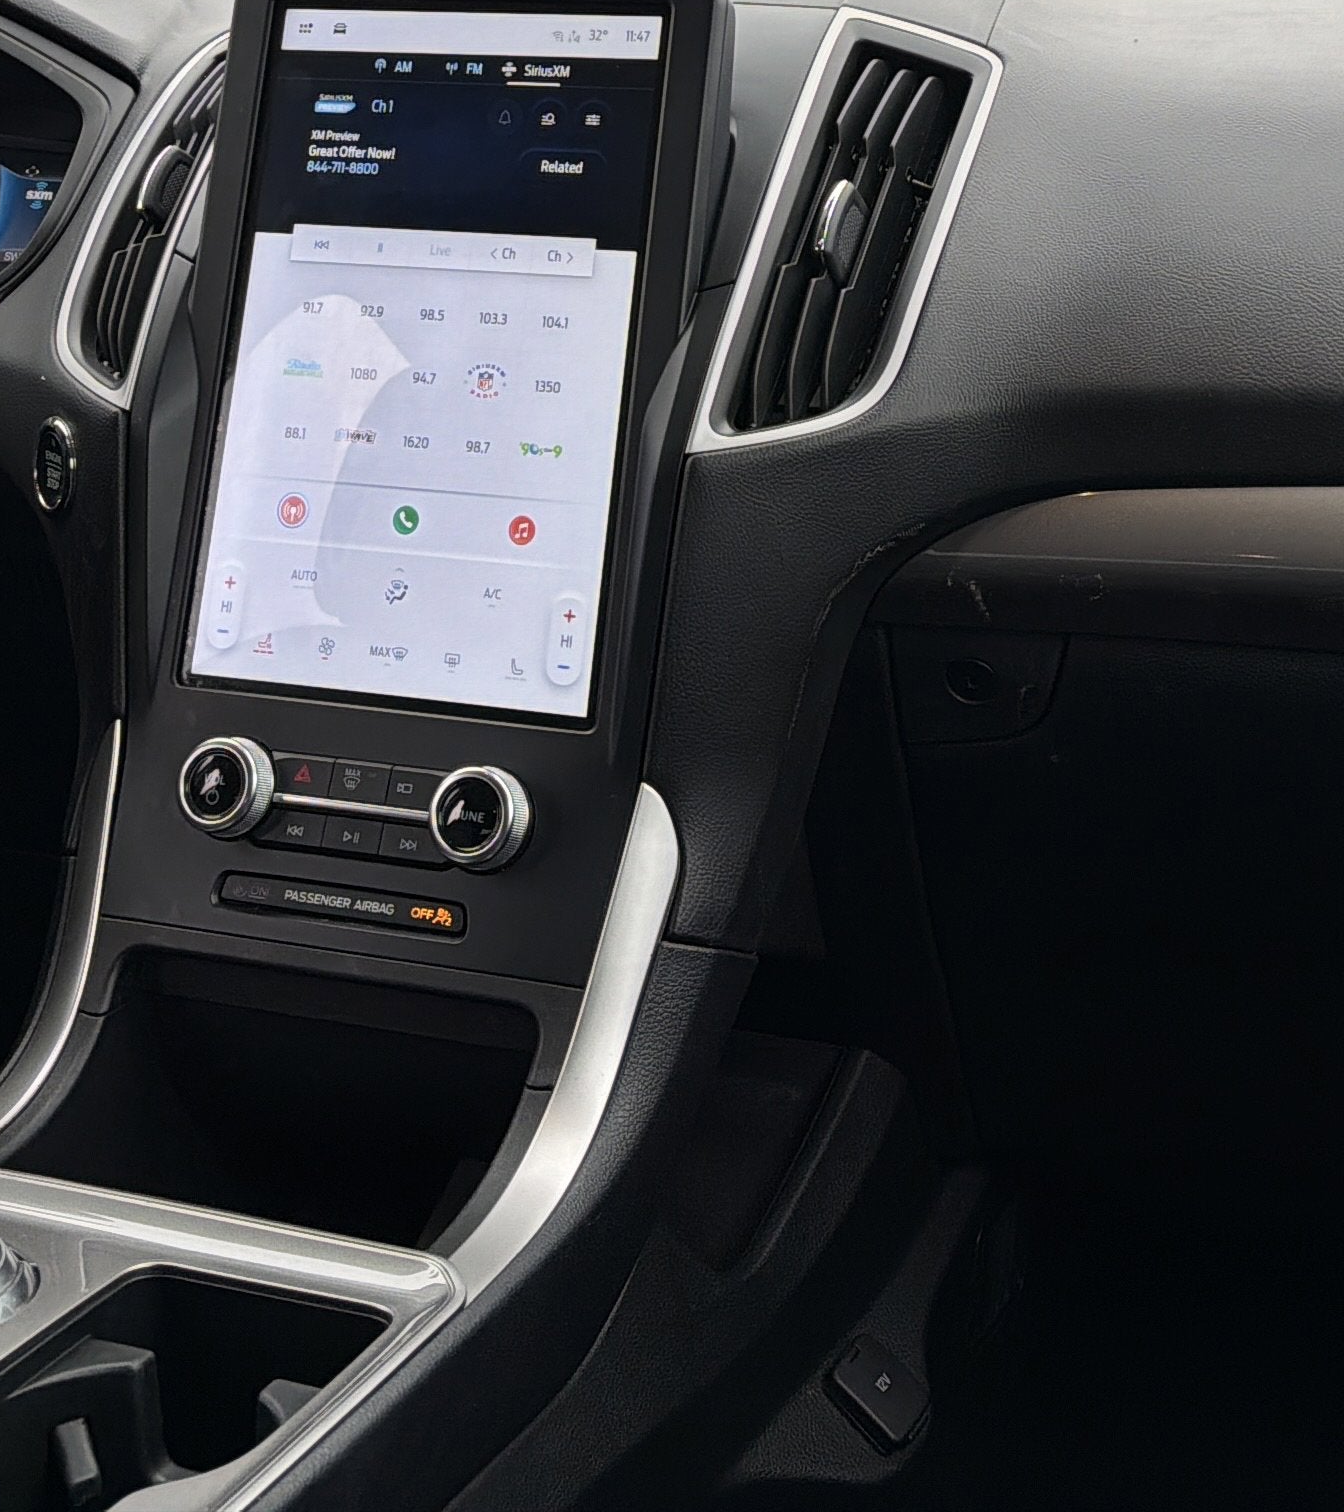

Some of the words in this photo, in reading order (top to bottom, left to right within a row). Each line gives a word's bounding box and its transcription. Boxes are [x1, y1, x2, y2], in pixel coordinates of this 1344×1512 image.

[588, 29, 609, 42] 32°
[626, 30, 651, 43] 11:47
[393, 61, 412, 74] AM
[466, 63, 483, 76] FM
[523, 64, 570, 79] SiriusXM
[371, 99, 387, 113] Ch
[388, 100, 394, 113] 1
[310, 129, 326, 141] XM
[326, 130, 361, 142] Preview
[308, 144, 338, 157] Great
[339, 146, 367, 159] Offer
[367, 147, 396, 160] Now!
[307, 160, 379, 175] 844-711-8800
[540, 160, 583, 175] Related
[25, 190, 54, 201] sxm
[429, 243, 451, 257] Live
[502, 247, 517, 261] Ch
[547, 250, 562, 263] Ch
[303, 302, 324, 315] 91.7
[360, 305, 384, 319] 92.9
[420, 308, 445, 322] 98.5
[479, 312, 508, 326] 103.3
[542, 315, 569, 330] 104.1
[350, 367, 378, 381] 1080
[412, 372, 436, 385] 94.7
[535, 380, 561, 394] 1350
[284, 426, 306, 440] 88.1
[403, 436, 430, 450] 1620
[466, 440, 491, 455] 98.7
[291, 569, 318, 582] AUTO
[483, 587, 502, 601] A/C
[220, 600, 233, 614] HI
[560, 635, 573, 648] HI
[369, 645, 391, 658] MAX
[344, 767, 361, 777] MAX
[457, 808, 486, 824] UNE
[284, 889, 352, 909] PASSENGER
[353, 899, 395, 915] AIRBAG
[410, 906, 434, 920] OFF
[874, 1372, 891, 1393] 12V
